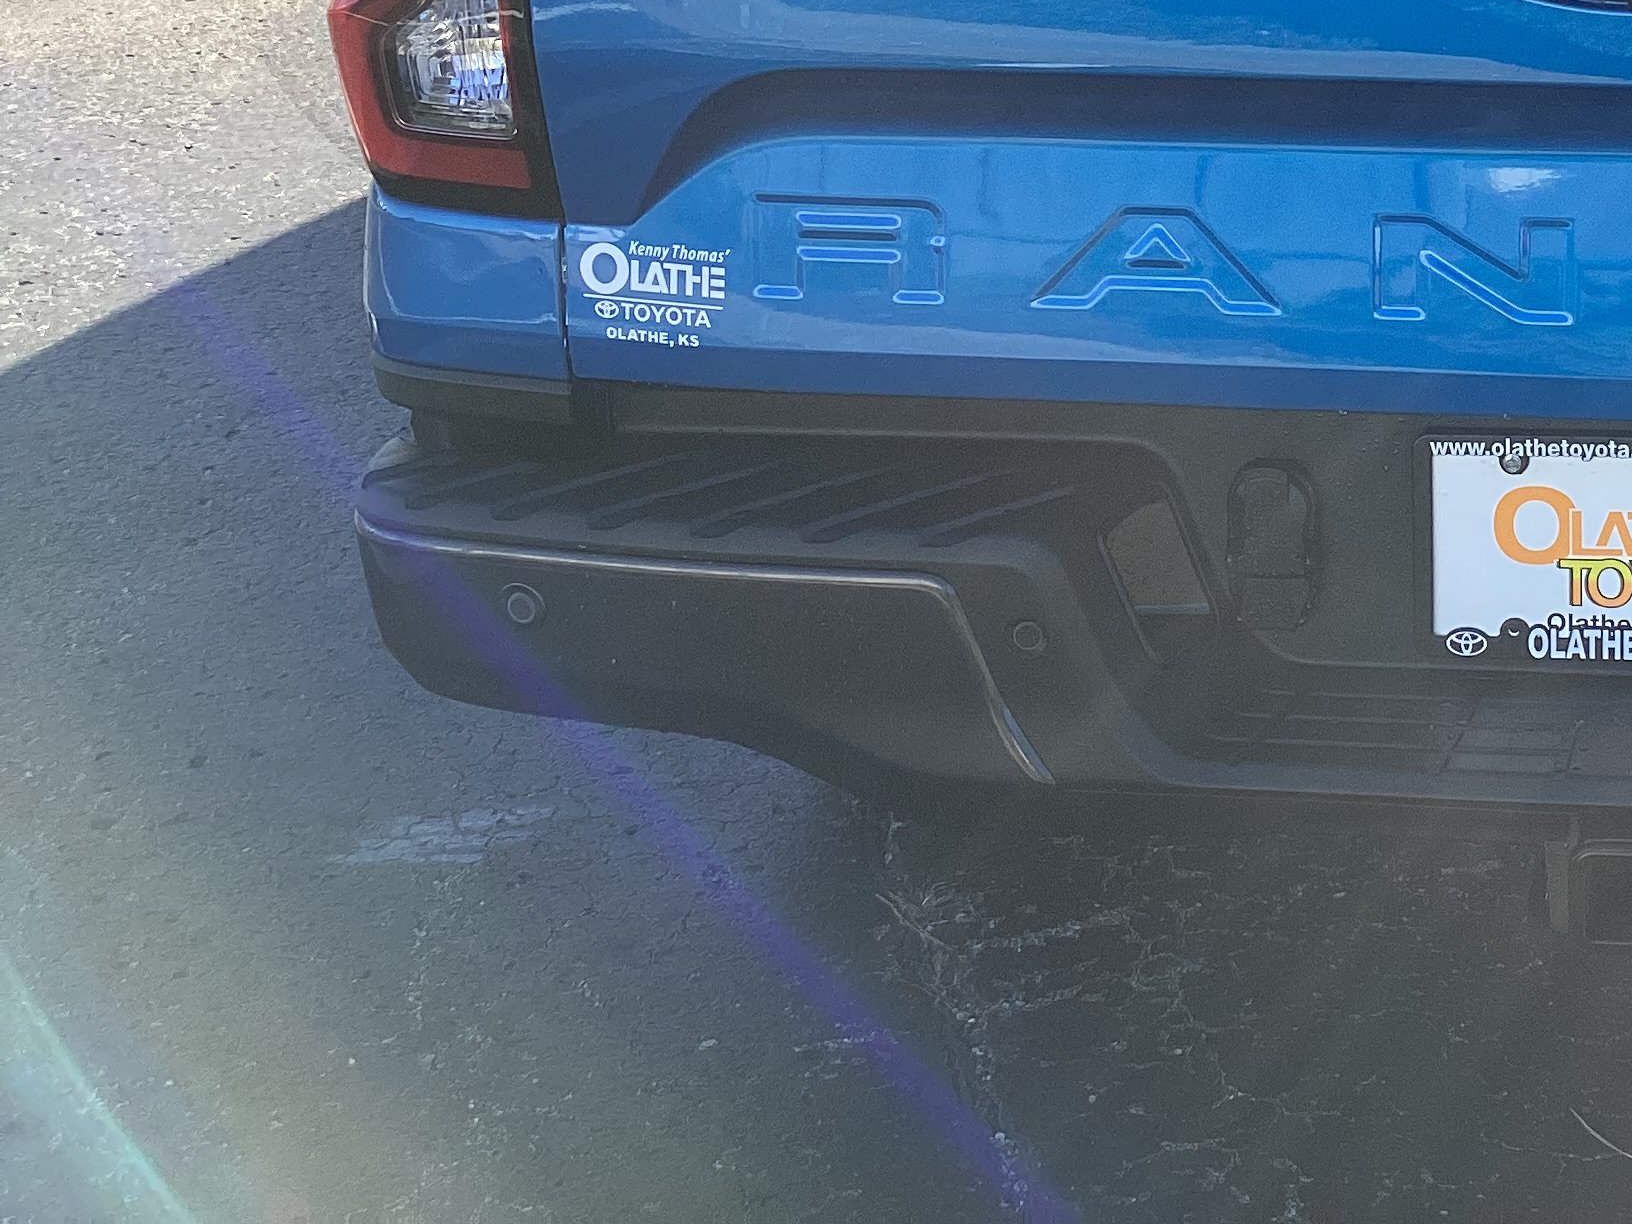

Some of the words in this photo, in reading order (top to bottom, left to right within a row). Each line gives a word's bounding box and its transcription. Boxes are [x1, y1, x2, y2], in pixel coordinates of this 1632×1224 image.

[629, 240, 669, 261] Kenny
[672, 244, 730, 263] Thomas'
[580, 242, 726, 299] OLATHE
[621, 302, 712, 328] TOYOTA
[606, 326, 675, 348] OLATHE,
[678, 333, 700, 347] KS
